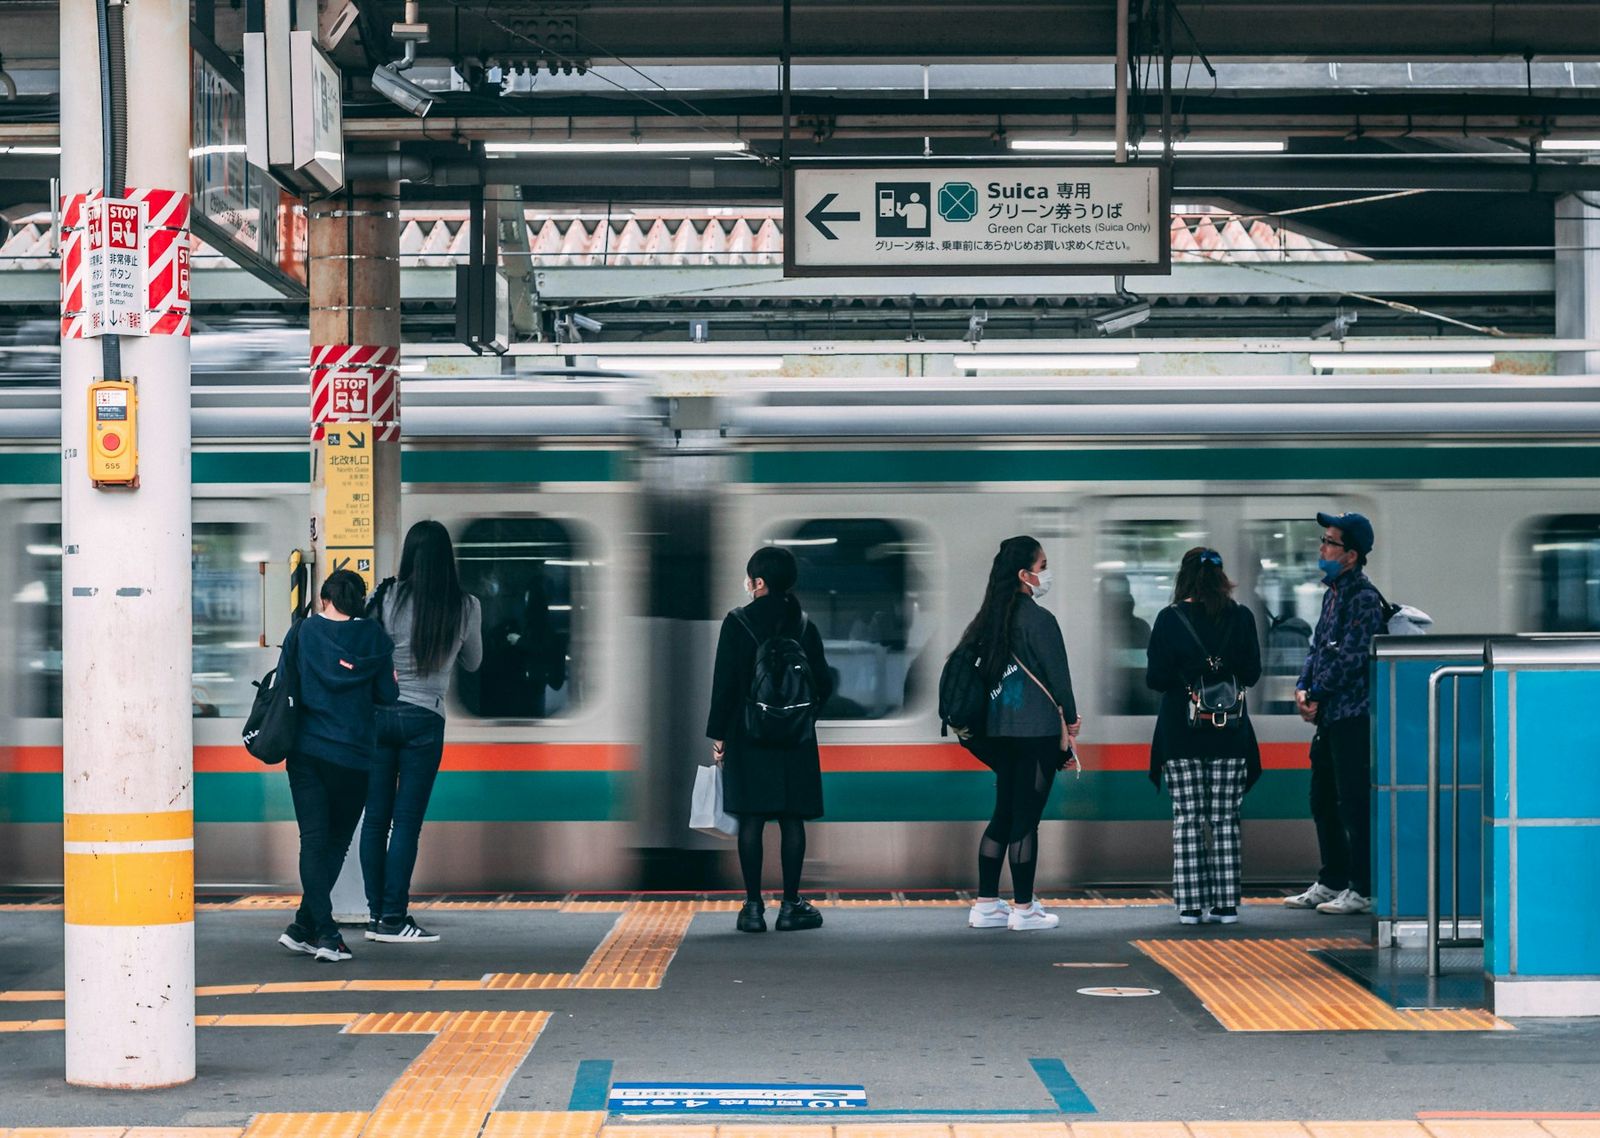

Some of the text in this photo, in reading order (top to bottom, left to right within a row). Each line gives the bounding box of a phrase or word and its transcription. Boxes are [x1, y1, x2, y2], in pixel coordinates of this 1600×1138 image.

[987, 182, 1091, 200] Suica 専用
[109, 205, 138, 220] STOP
[988, 203, 1123, 220] グリーン券うりば
[988, 222, 1151, 234] Green Car Tickets (Suica Only)
[875, 240, 1130, 251] グリーン券は、乗車前にあらかじめお買い求めください。
[109, 253, 139, 267] 非常停止
[109, 268, 132, 281] ボタン
[334, 379, 367, 390] STOP
[329, 455, 370, 465] 北改札口
[352, 493, 370, 502] 東口
[352, 517, 370, 526] 西口
